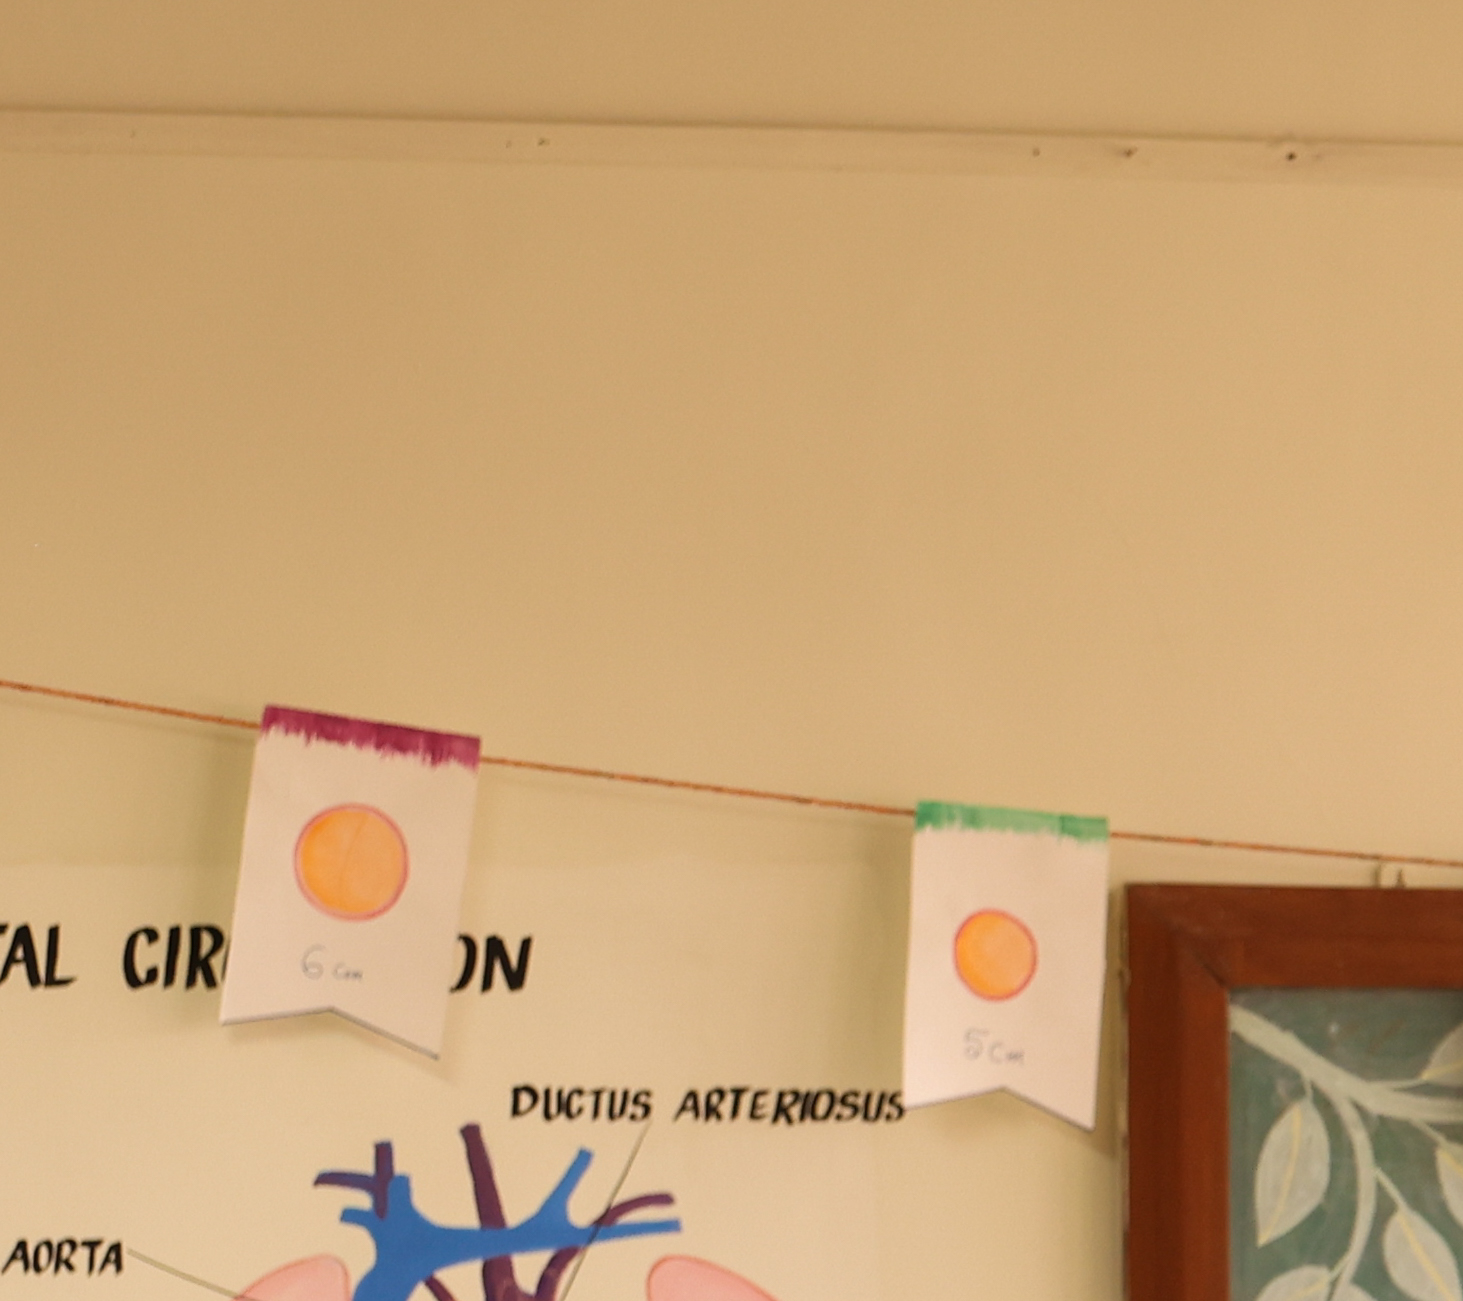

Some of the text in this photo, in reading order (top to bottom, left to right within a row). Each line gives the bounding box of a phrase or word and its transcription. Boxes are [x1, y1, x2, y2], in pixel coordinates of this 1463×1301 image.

[301, 943, 326, 980] 6
[963, 1027, 989, 1060] 5
[511, 1084, 906, 1127] DUCTUS ARTERIOSUS
[1, 1237, 123, 1276] AORTA
